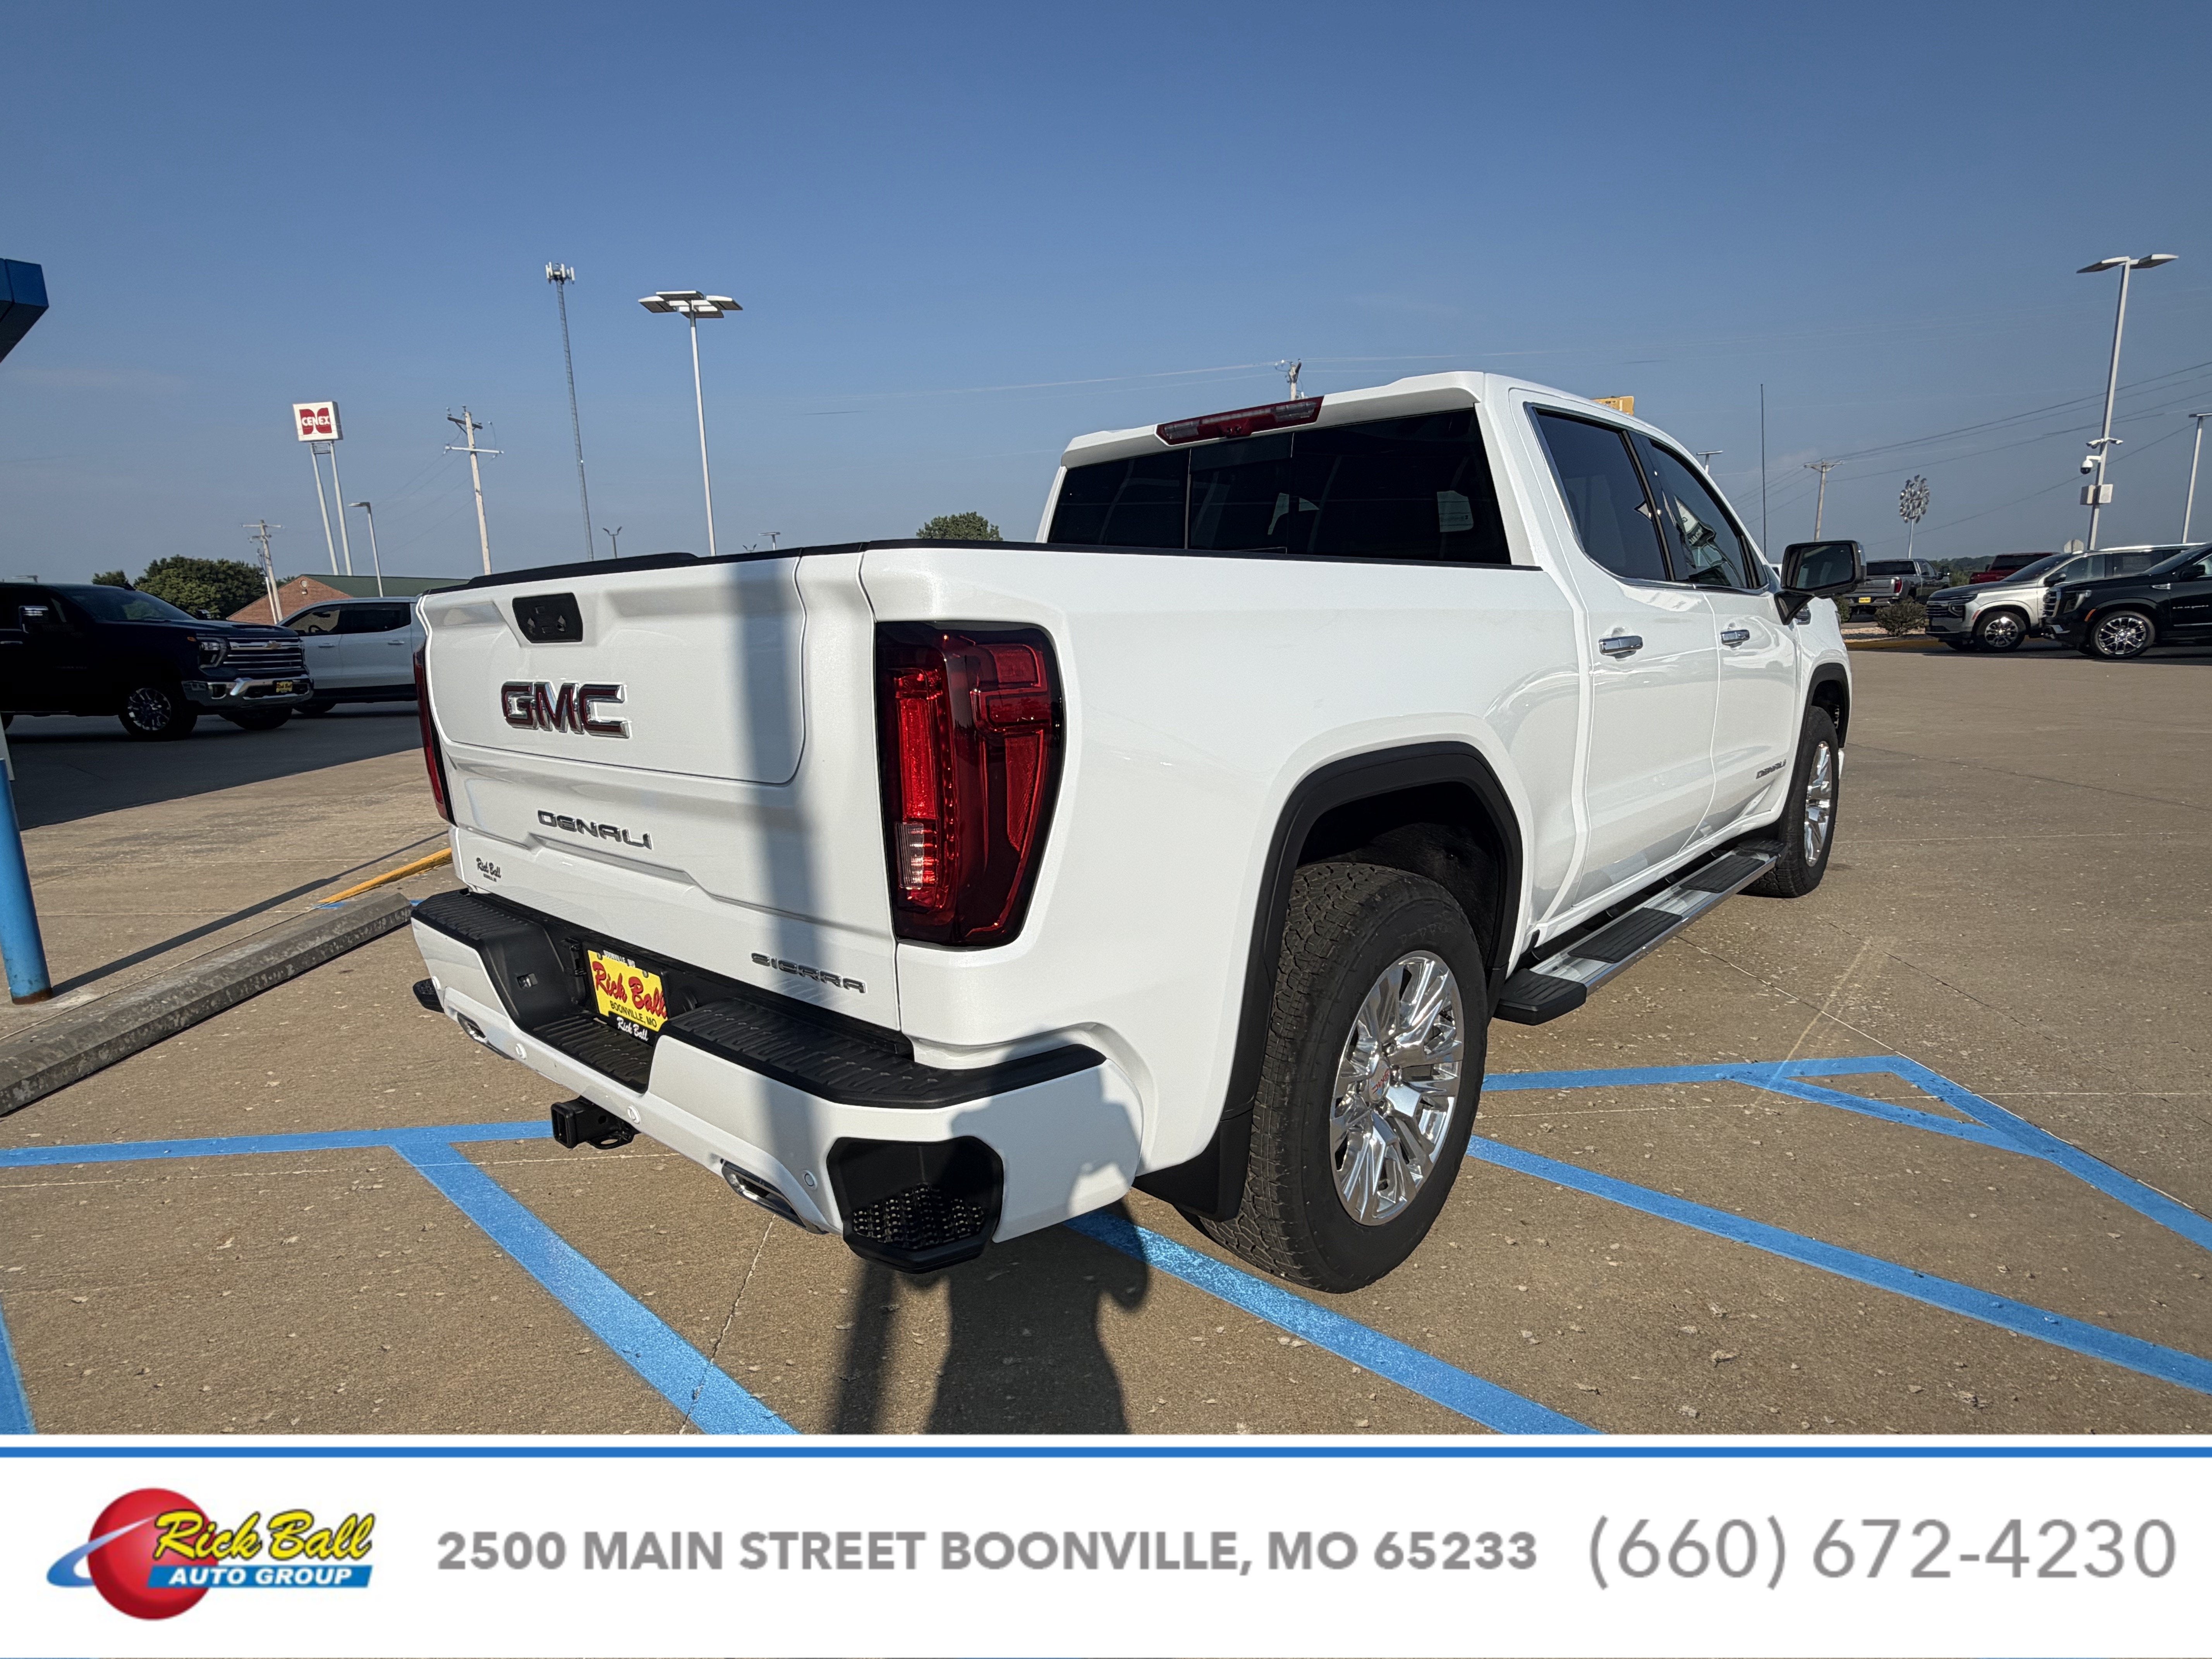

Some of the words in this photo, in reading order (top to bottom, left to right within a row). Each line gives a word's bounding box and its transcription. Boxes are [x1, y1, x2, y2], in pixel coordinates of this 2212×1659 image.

[302, 416, 330, 426] CENEX
[501, 680, 630, 739] GMC
[538, 810, 653, 850] DENALI
[592, 961, 628, 1003] Rick
[628, 976, 667, 1019] Ball
[751, 952, 866, 994] SIERRA
[610, 1000, 646, 1024] BOONVILLE,
[646, 1016, 657, 1028] MO
[617, 1017, 632, 1034] Rick
[632, 1024, 649, 1041] Ball
